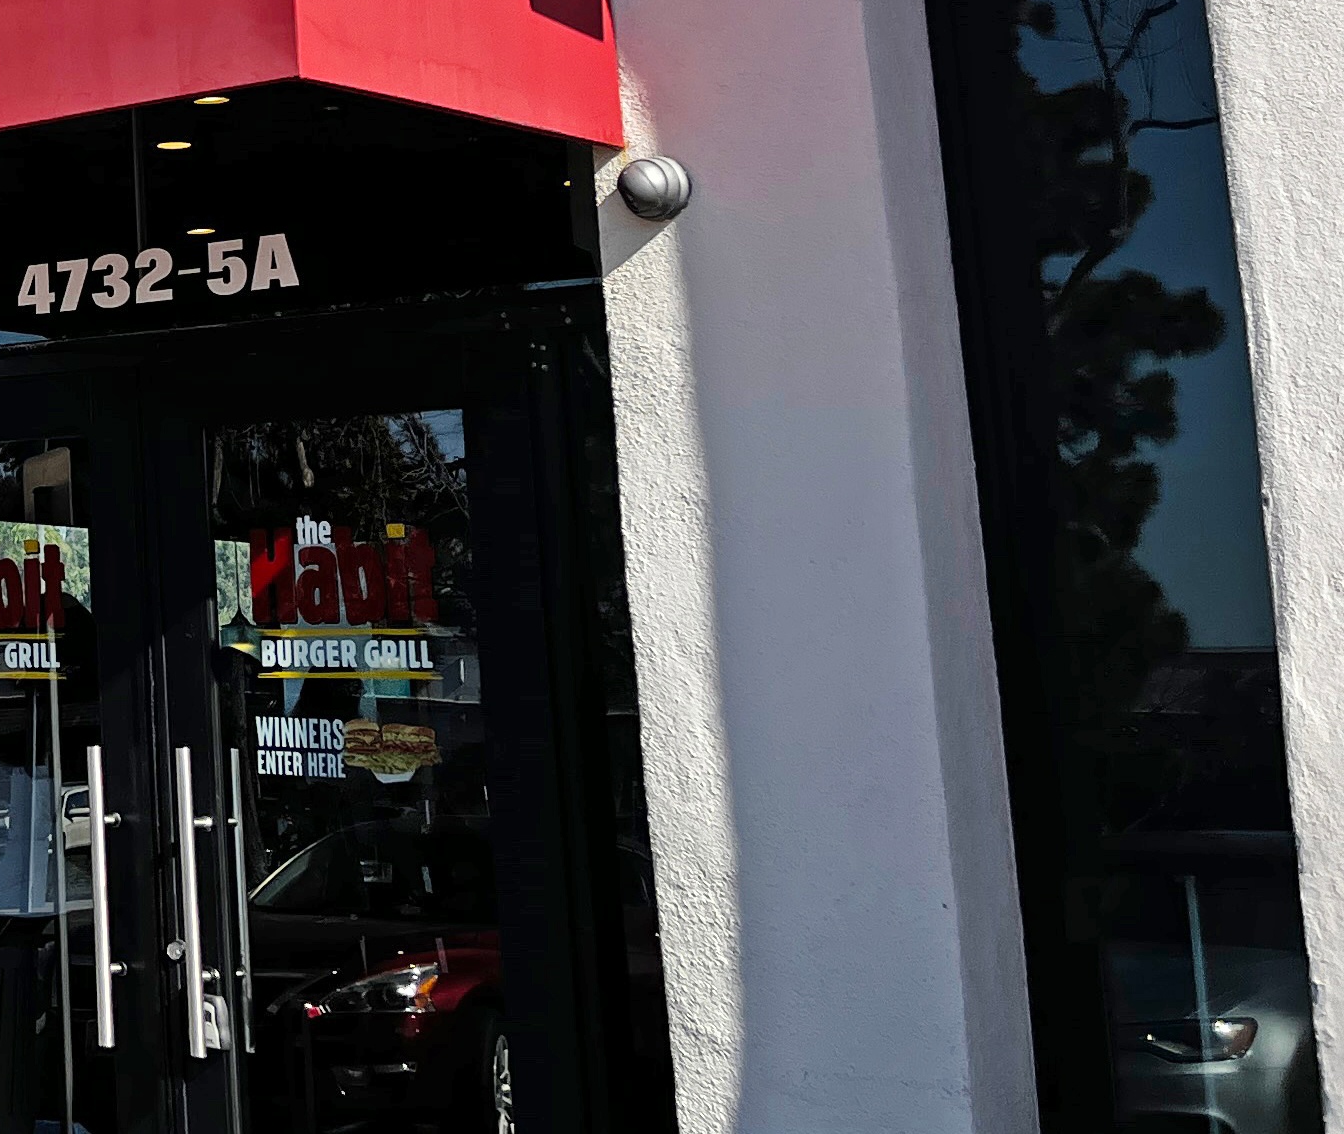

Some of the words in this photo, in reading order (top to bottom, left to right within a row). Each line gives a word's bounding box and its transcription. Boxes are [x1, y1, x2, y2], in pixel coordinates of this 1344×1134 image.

[18, 233, 300, 314] 4732-5A
[296, 515, 332, 545] the
[250, 523, 439, 625] Habit
[4, 642, 61, 669] GRILL
[261, 639, 358, 668] BURGER
[364, 639, 434, 669] GRILL
[256, 716, 345, 751] WINNERS
[257, 749, 303, 778] ENTER
[308, 752, 346, 778] HERE
